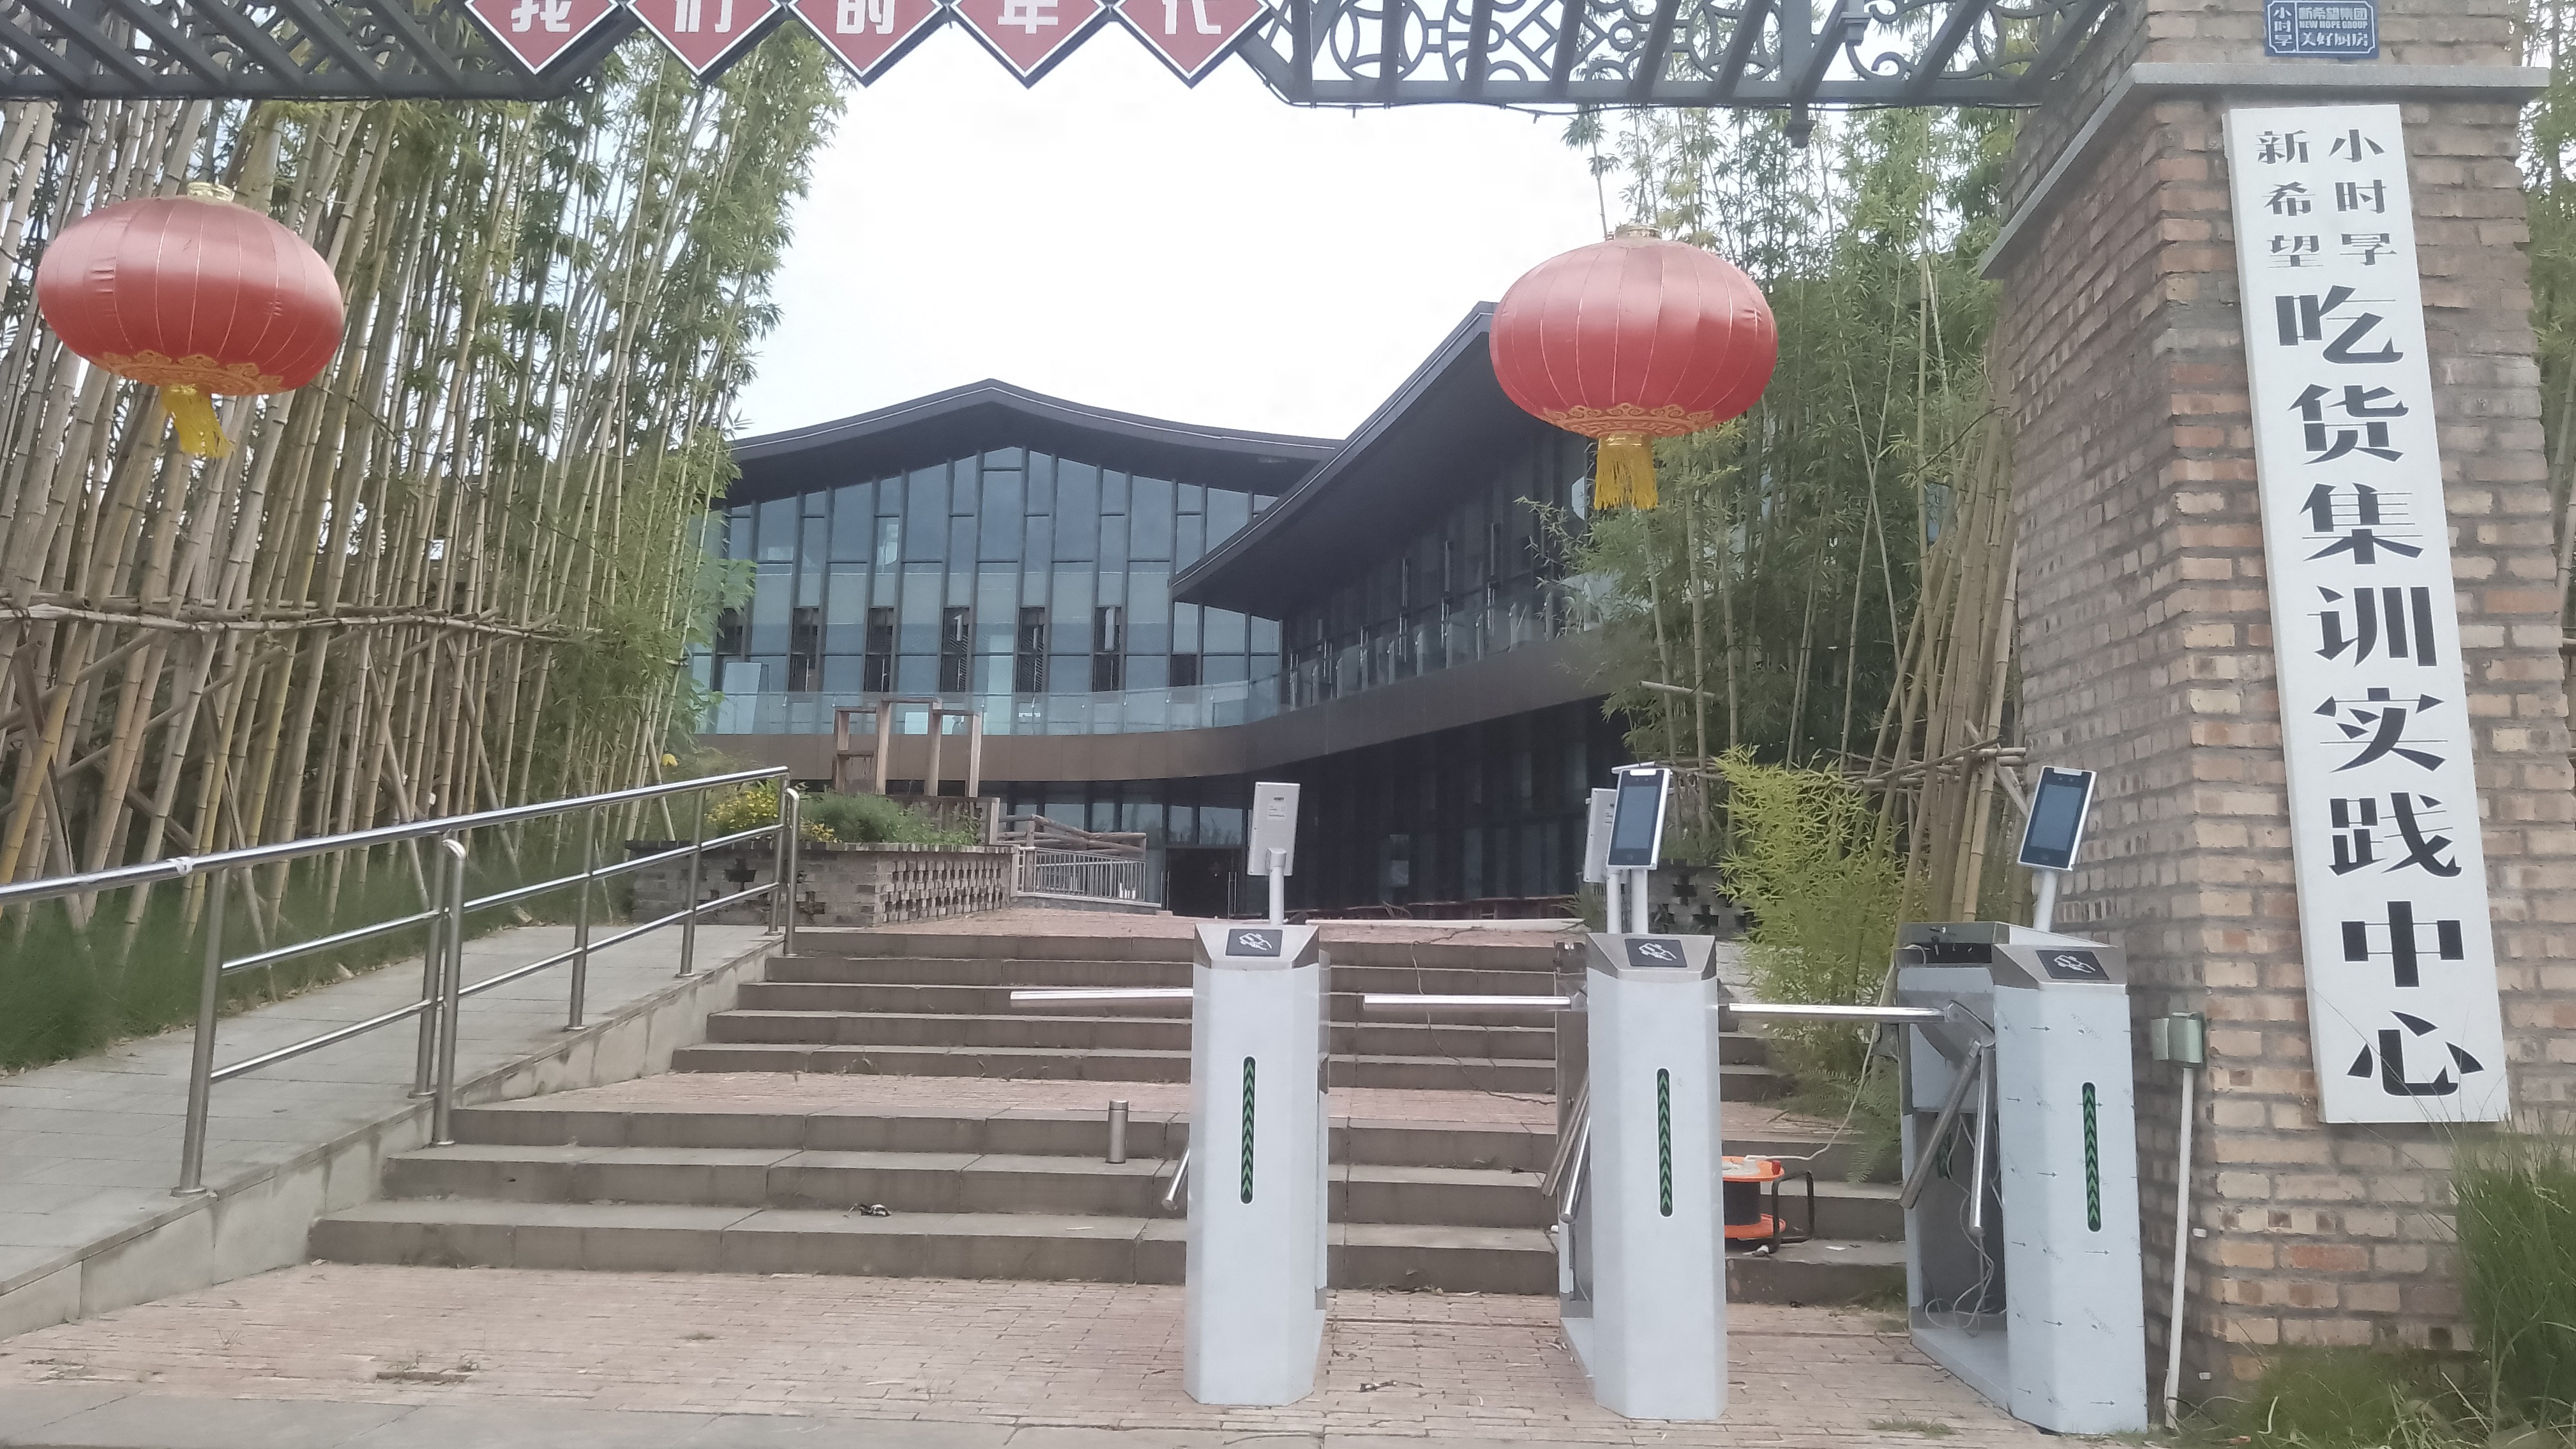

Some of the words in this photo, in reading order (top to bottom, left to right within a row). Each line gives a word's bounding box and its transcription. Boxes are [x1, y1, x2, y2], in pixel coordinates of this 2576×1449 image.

[2298, 7, 2367, 20] 新希望集团
[2299, 20, 2317, 29] NEW
[2319, 20, 2340, 29] HOPE
[2342, 20, 2368, 29] GROUP
[2255, 130, 2324, 268] 新希望
[2274, 284, 2485, 1096] 吃货集训实践中心
